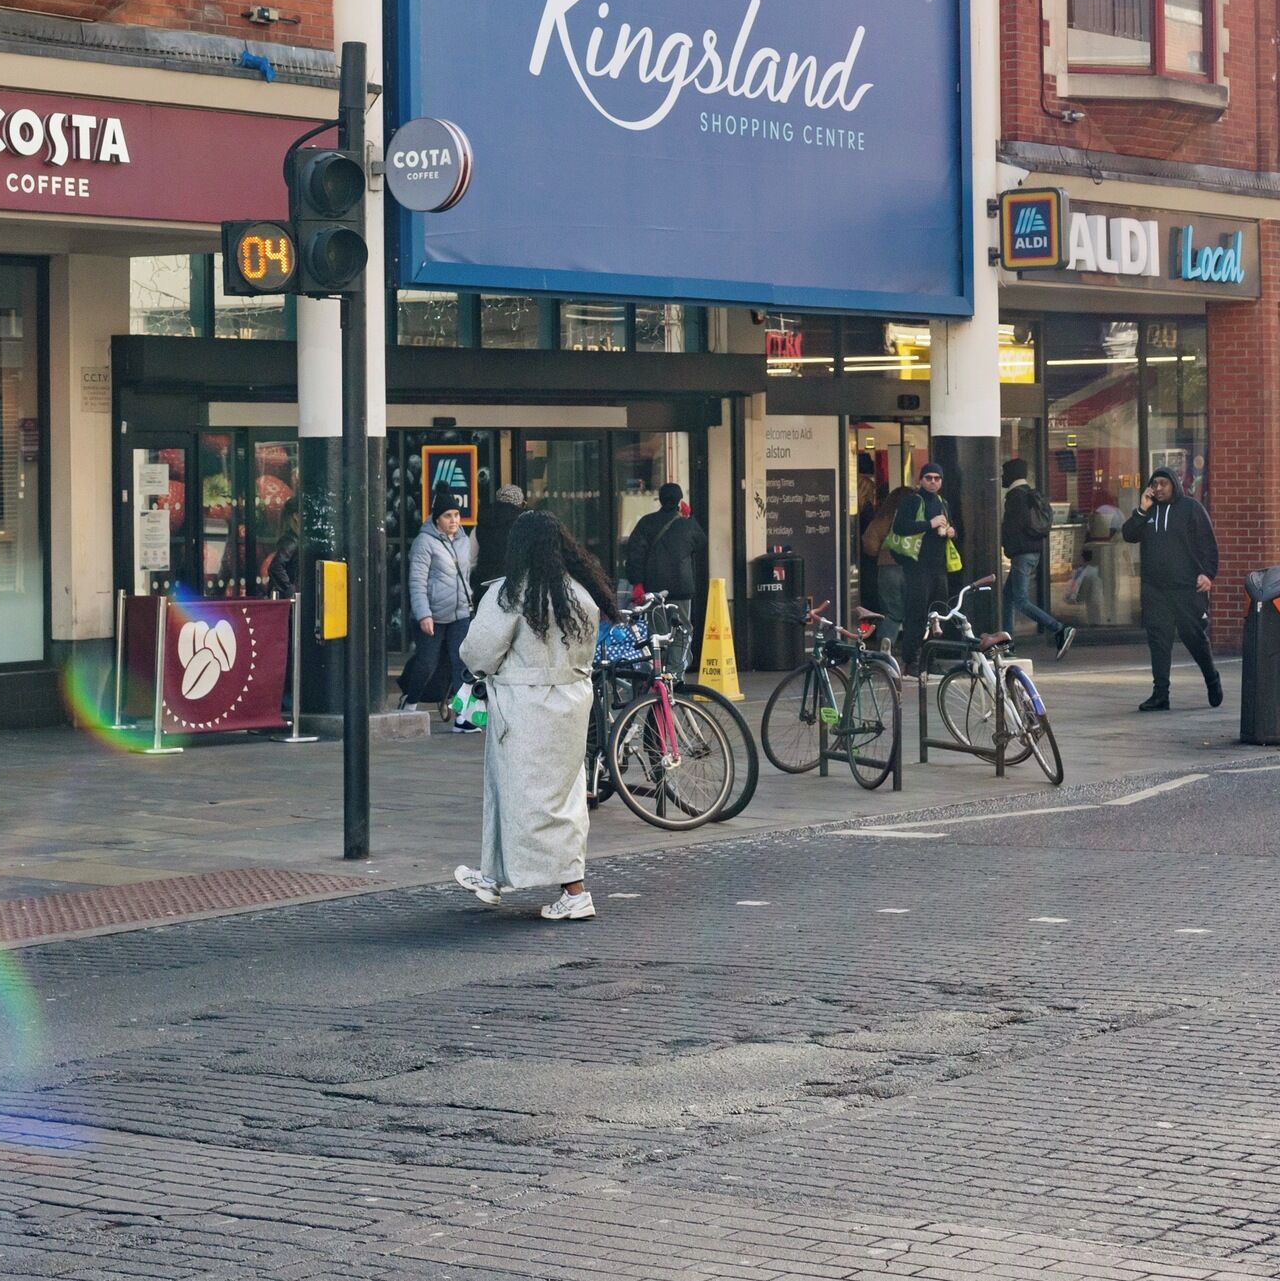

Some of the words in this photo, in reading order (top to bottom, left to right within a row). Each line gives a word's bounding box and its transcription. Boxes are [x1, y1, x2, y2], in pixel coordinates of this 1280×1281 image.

[700, 112, 794, 142] SHOPPING
[803, 125, 865, 151] CENTRE
[393, 148, 452, 170] COSTA
[406, 171, 440, 181] COFFEE
[6, 173, 90, 197] COFFEE
[1015, 237, 1048, 250] ALDI
[1067, 213, 1160, 277] ALDI
[1182, 224, 1245, 284] Local
[242, 236, 289, 280] 04
[766, 428, 790, 440] elcome
[766, 444, 791, 459] alston
[757, 583, 784, 592] LITTER
[702, 667, 720, 676] FLOOR
